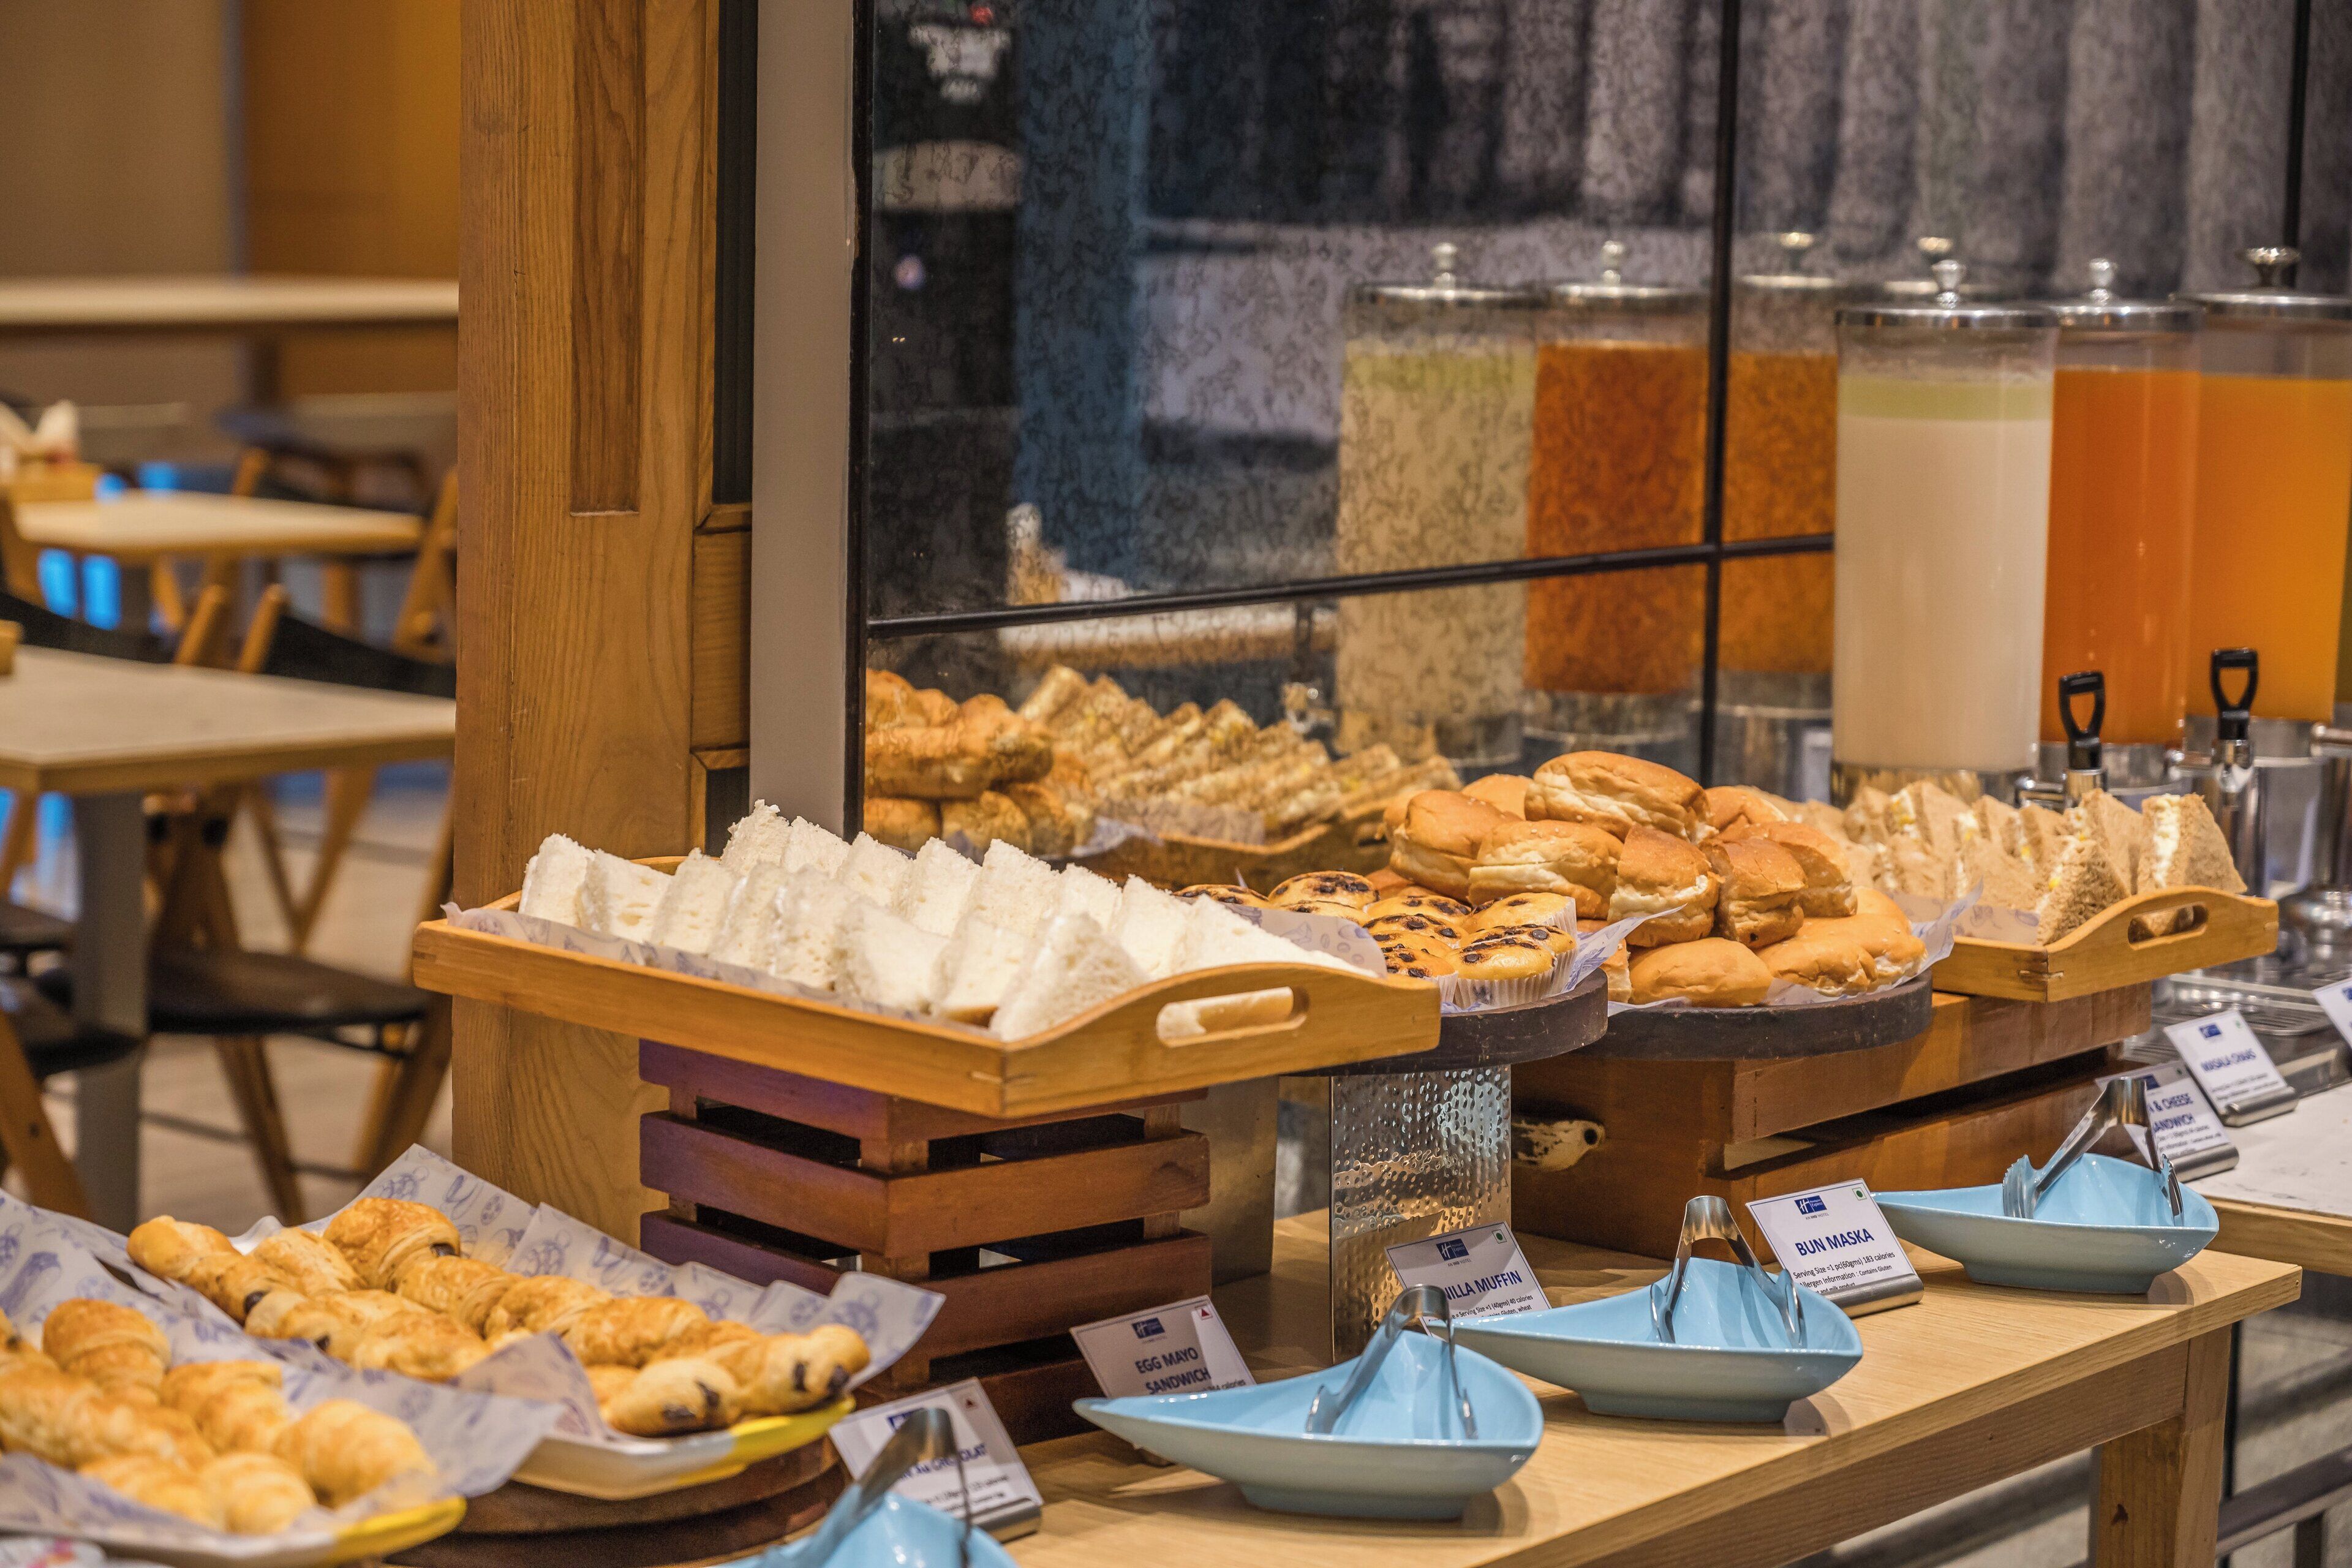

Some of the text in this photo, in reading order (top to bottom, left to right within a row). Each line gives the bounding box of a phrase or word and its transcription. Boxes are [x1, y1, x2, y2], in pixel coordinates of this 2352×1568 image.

[2152, 1113, 2195, 1133] ANDWICH
[1795, 1229, 1874, 1256] BUN MASKA
[1793, 1269, 1815, 1280] Serving
[1835, 1259, 1863, 1270] pc(60gms)
[1874, 1251, 1895, 1261] calories
[1823, 1272, 1855, 1284] Information
[1444, 1270, 1523, 1300] NILLA MUFFIN
[1491, 1300, 1510, 1309] (40gms)
[1135, 1348, 1199, 1373] EGG MAYO
[1146, 1368, 1212, 1394] SANDWICH
